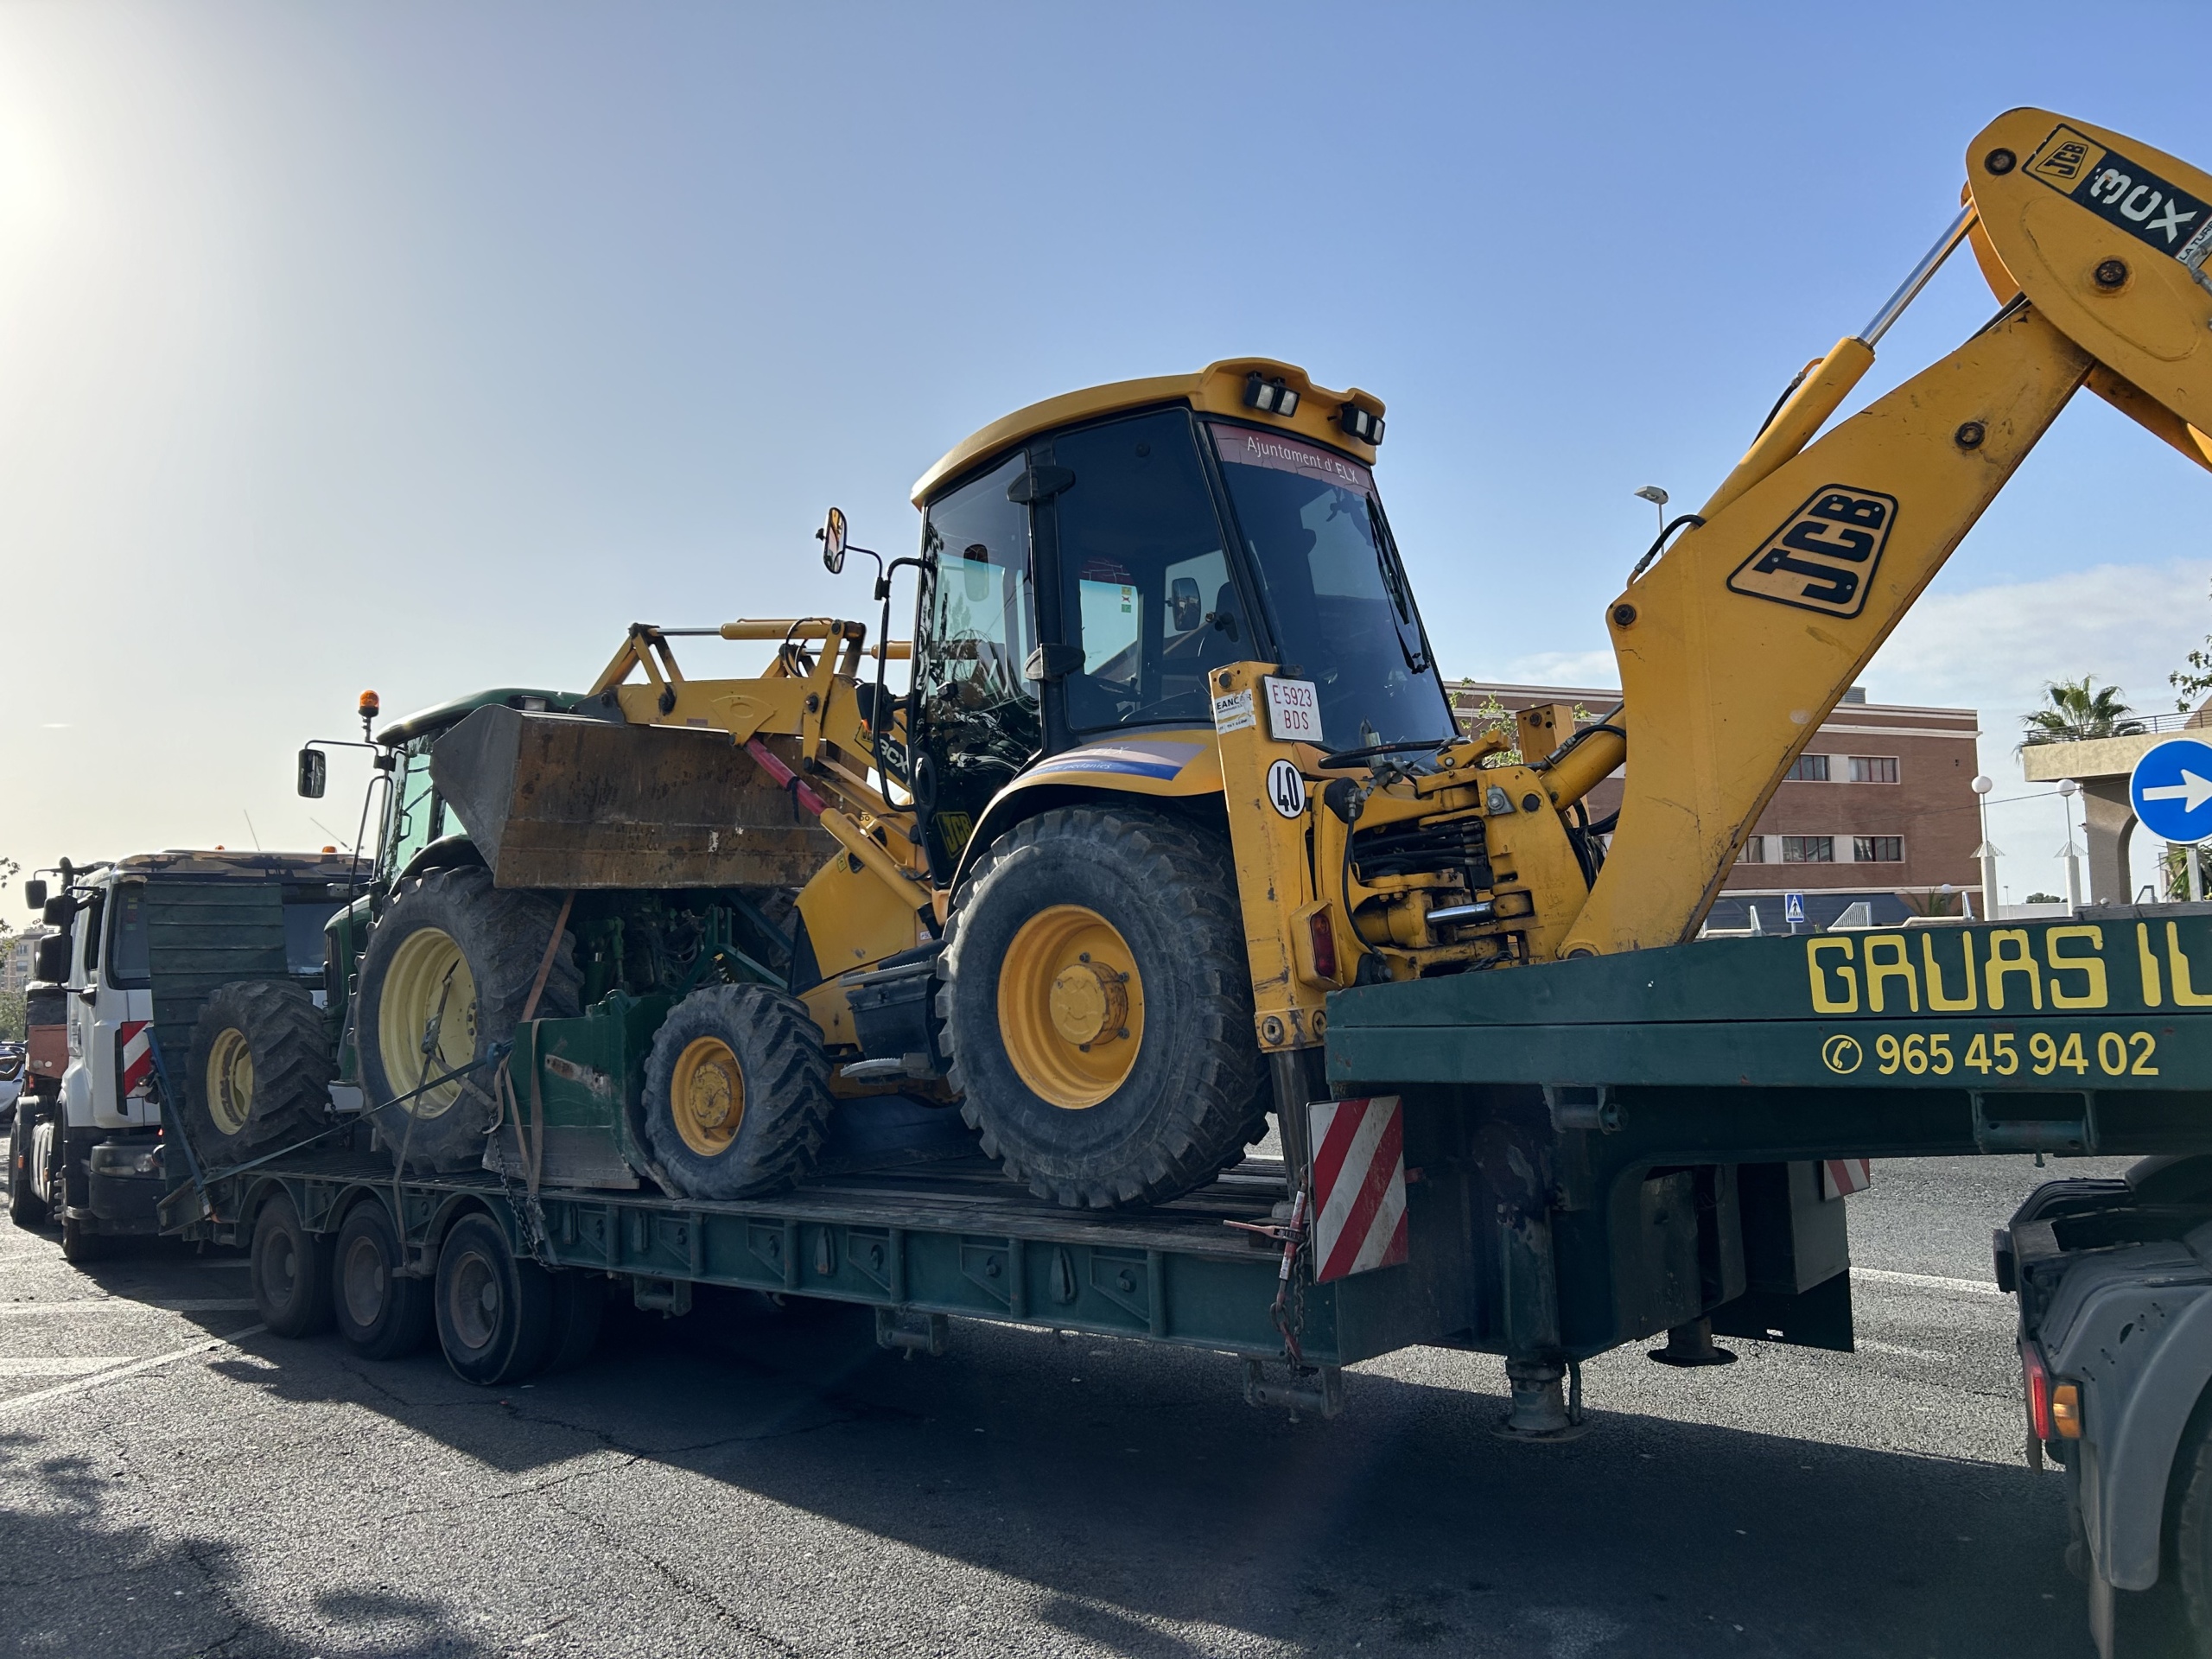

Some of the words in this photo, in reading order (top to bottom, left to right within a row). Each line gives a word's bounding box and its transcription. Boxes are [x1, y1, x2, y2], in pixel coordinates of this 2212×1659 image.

[2044, 143, 2085, 175] JCB
[2090, 168, 2198, 244] 3CX
[1247, 435, 1322, 469] Ajuntament
[1325, 458, 1332, 472] d'
[1334, 461, 1359, 485] ELX
[1751, 494, 1885, 604] JCB
[1272, 684, 1281, 704] E
[1282, 686, 1313, 707] 5923
[1283, 709, 1309, 730] BDS
[879, 738, 908, 774] 3CX
[1276, 766, 1300, 812] 40
[943, 816, 972, 853] JCB
[1807, 925, 2108, 1014] GRUAS
[1875, 1033, 1954, 1075] 965
[1964, 1033, 2018, 1075] 45
[2029, 1033, 2089, 1076] 94
[2097, 1031, 2159, 1076] 02
